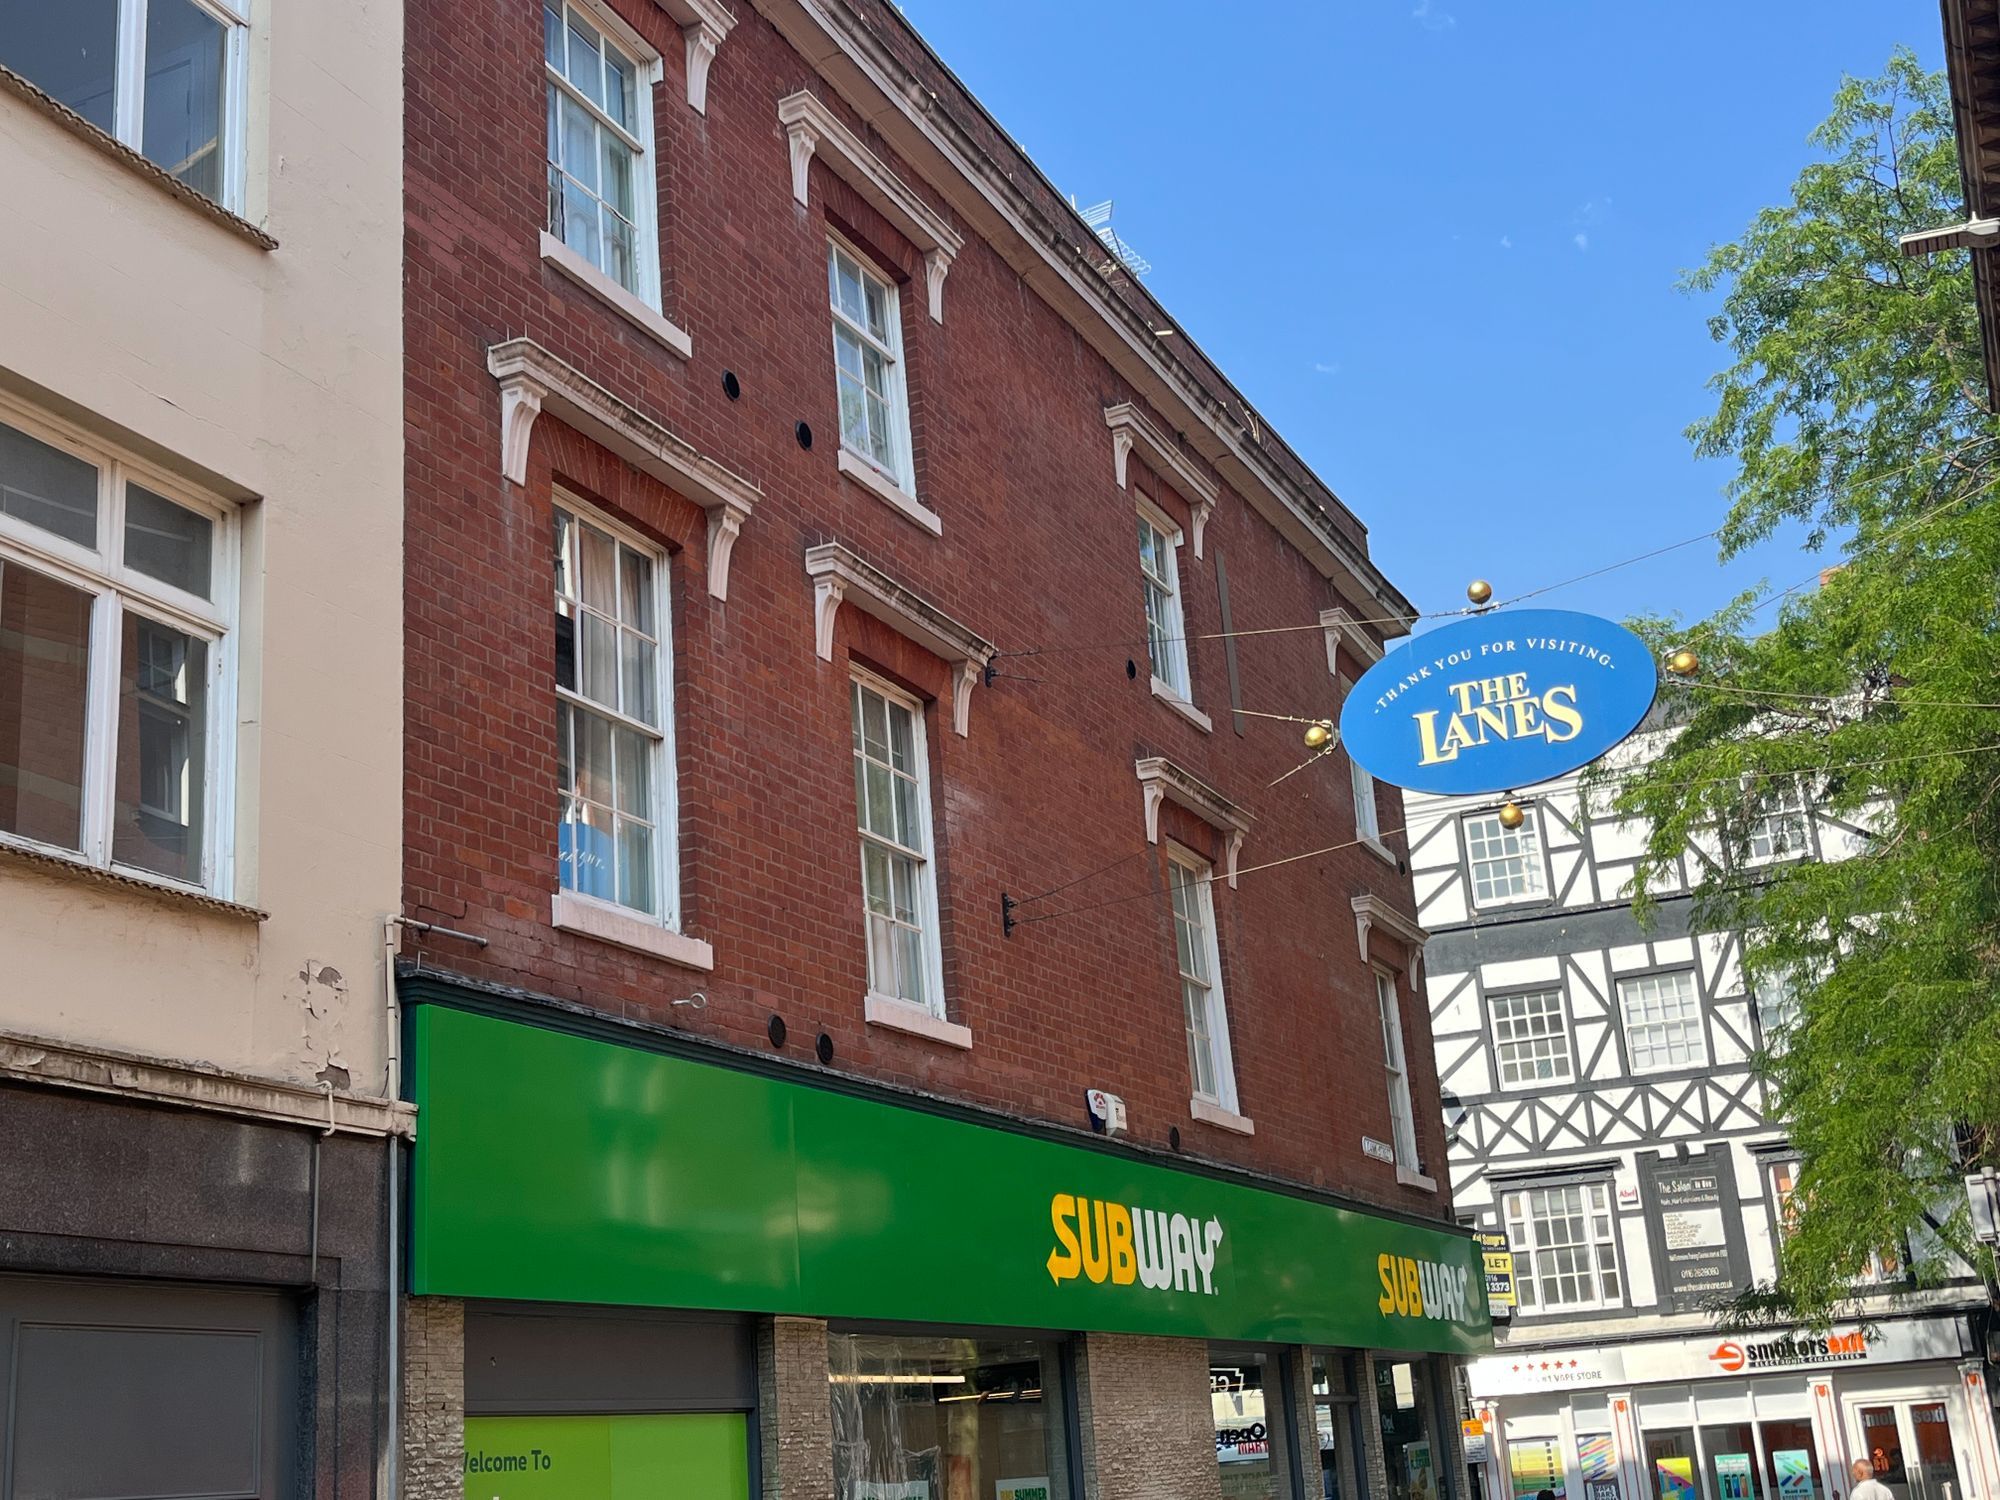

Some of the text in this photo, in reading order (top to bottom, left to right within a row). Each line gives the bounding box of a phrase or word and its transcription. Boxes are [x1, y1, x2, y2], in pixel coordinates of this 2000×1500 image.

[1435, 649, 1472, 671] YOU
[1480, 640, 1516, 656] FOR
[1449, 672, 1530, 717] THE
[1412, 684, 1583, 767] LANES
[1046, 1193, 1223, 1295] SUBWAY
[1488, 1259, 1508, 1268] LET
[1378, 1253, 1467, 1321] SUBWAY
[1553, 1374, 1574, 1382] VAPE
[1576, 1371, 1602, 1380] STORE
[464, 1450, 551, 1473] elcome To
